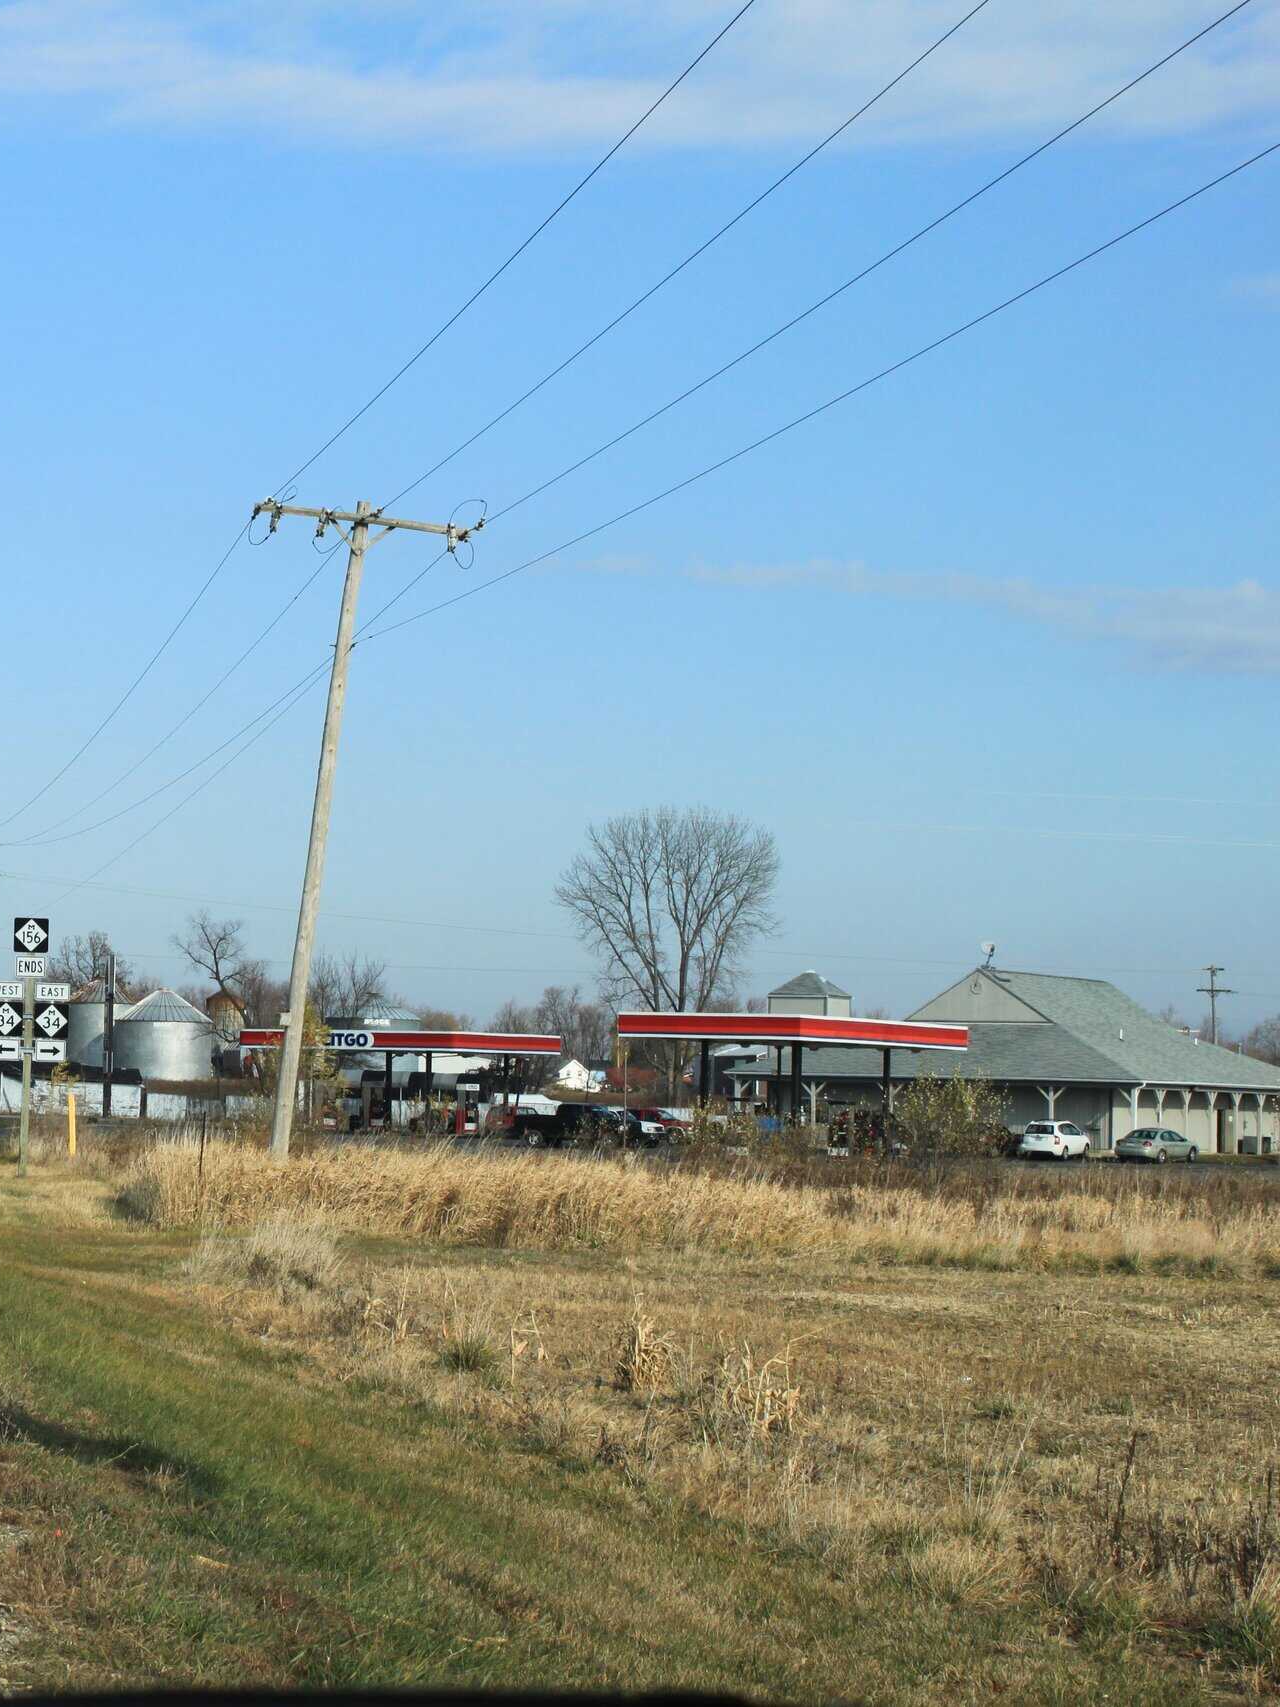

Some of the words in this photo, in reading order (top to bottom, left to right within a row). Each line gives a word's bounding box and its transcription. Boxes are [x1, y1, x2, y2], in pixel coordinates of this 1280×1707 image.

[22, 931, 41, 944] 156
[18, 960, 43, 973] ENDS
[41, 987, 65, 997] EAST
[42, 1016, 60, 1029] 34
